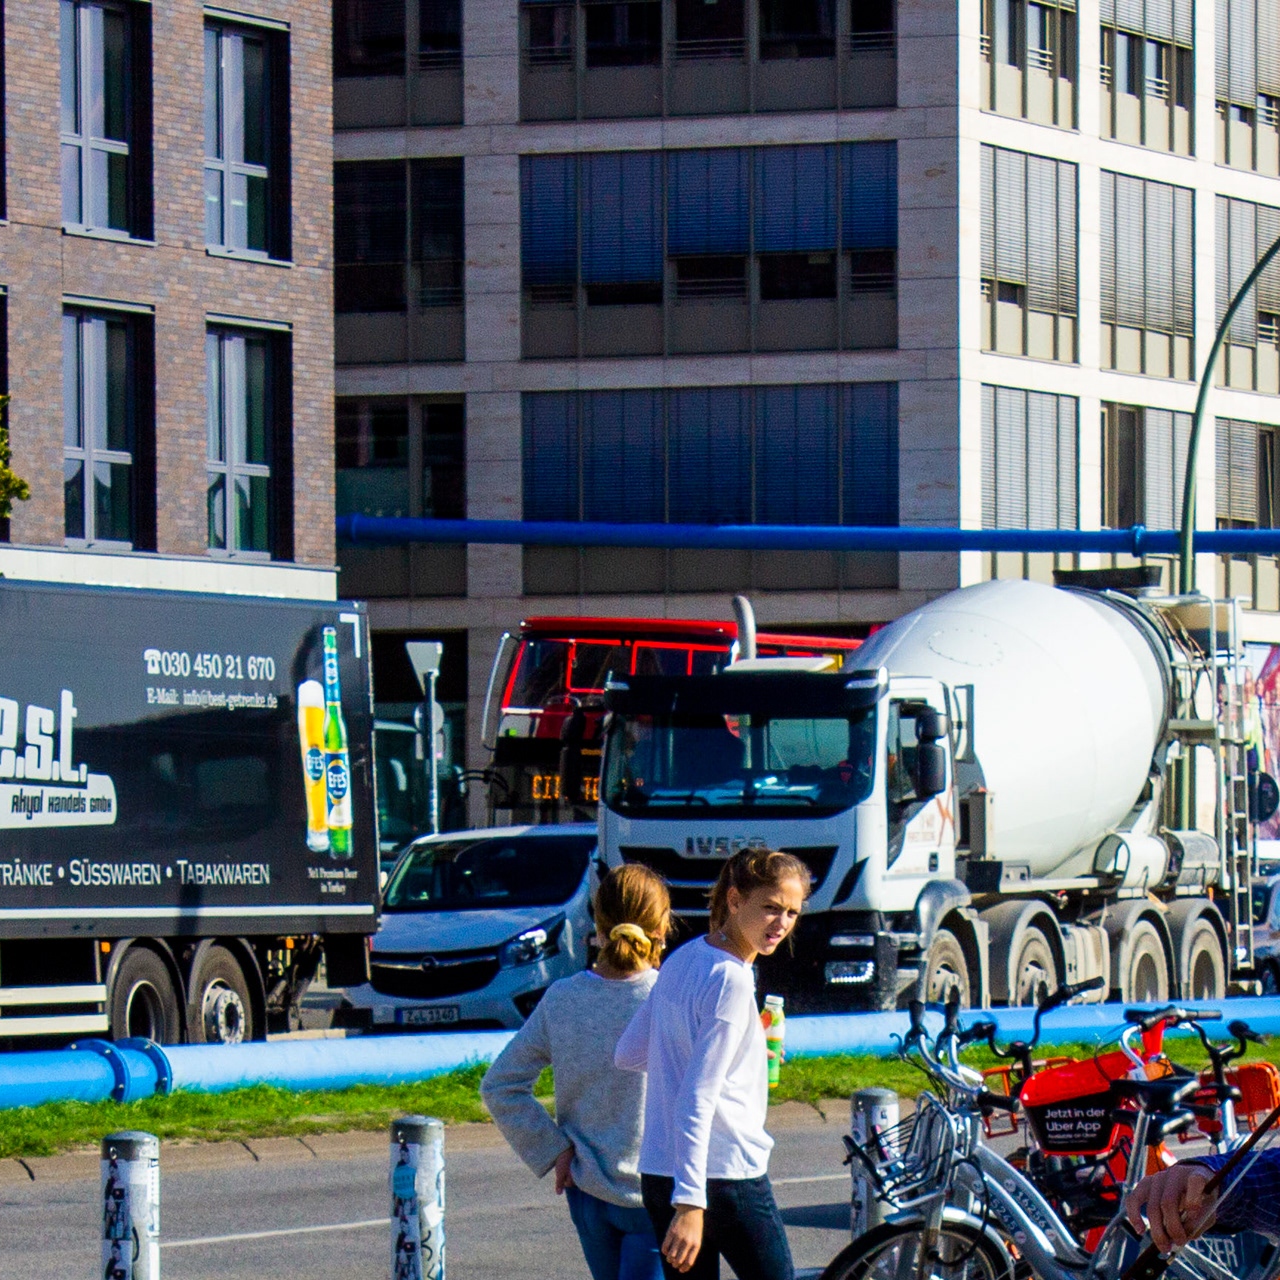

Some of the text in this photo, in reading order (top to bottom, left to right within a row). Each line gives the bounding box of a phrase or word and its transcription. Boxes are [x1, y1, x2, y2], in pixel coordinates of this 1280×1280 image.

[160, 651, 276, 681] 030 450 21 670
[328, 771, 348, 788] EFES
[686, 835, 767, 854] IVECO
[69, 858, 161, 885] SÜSSWAREN
[176, 860, 271, 886] TABAKWAREN
[1045, 1108, 1105, 1119] Jetzt in der
[1046, 1120, 1101, 1132] Uber App
